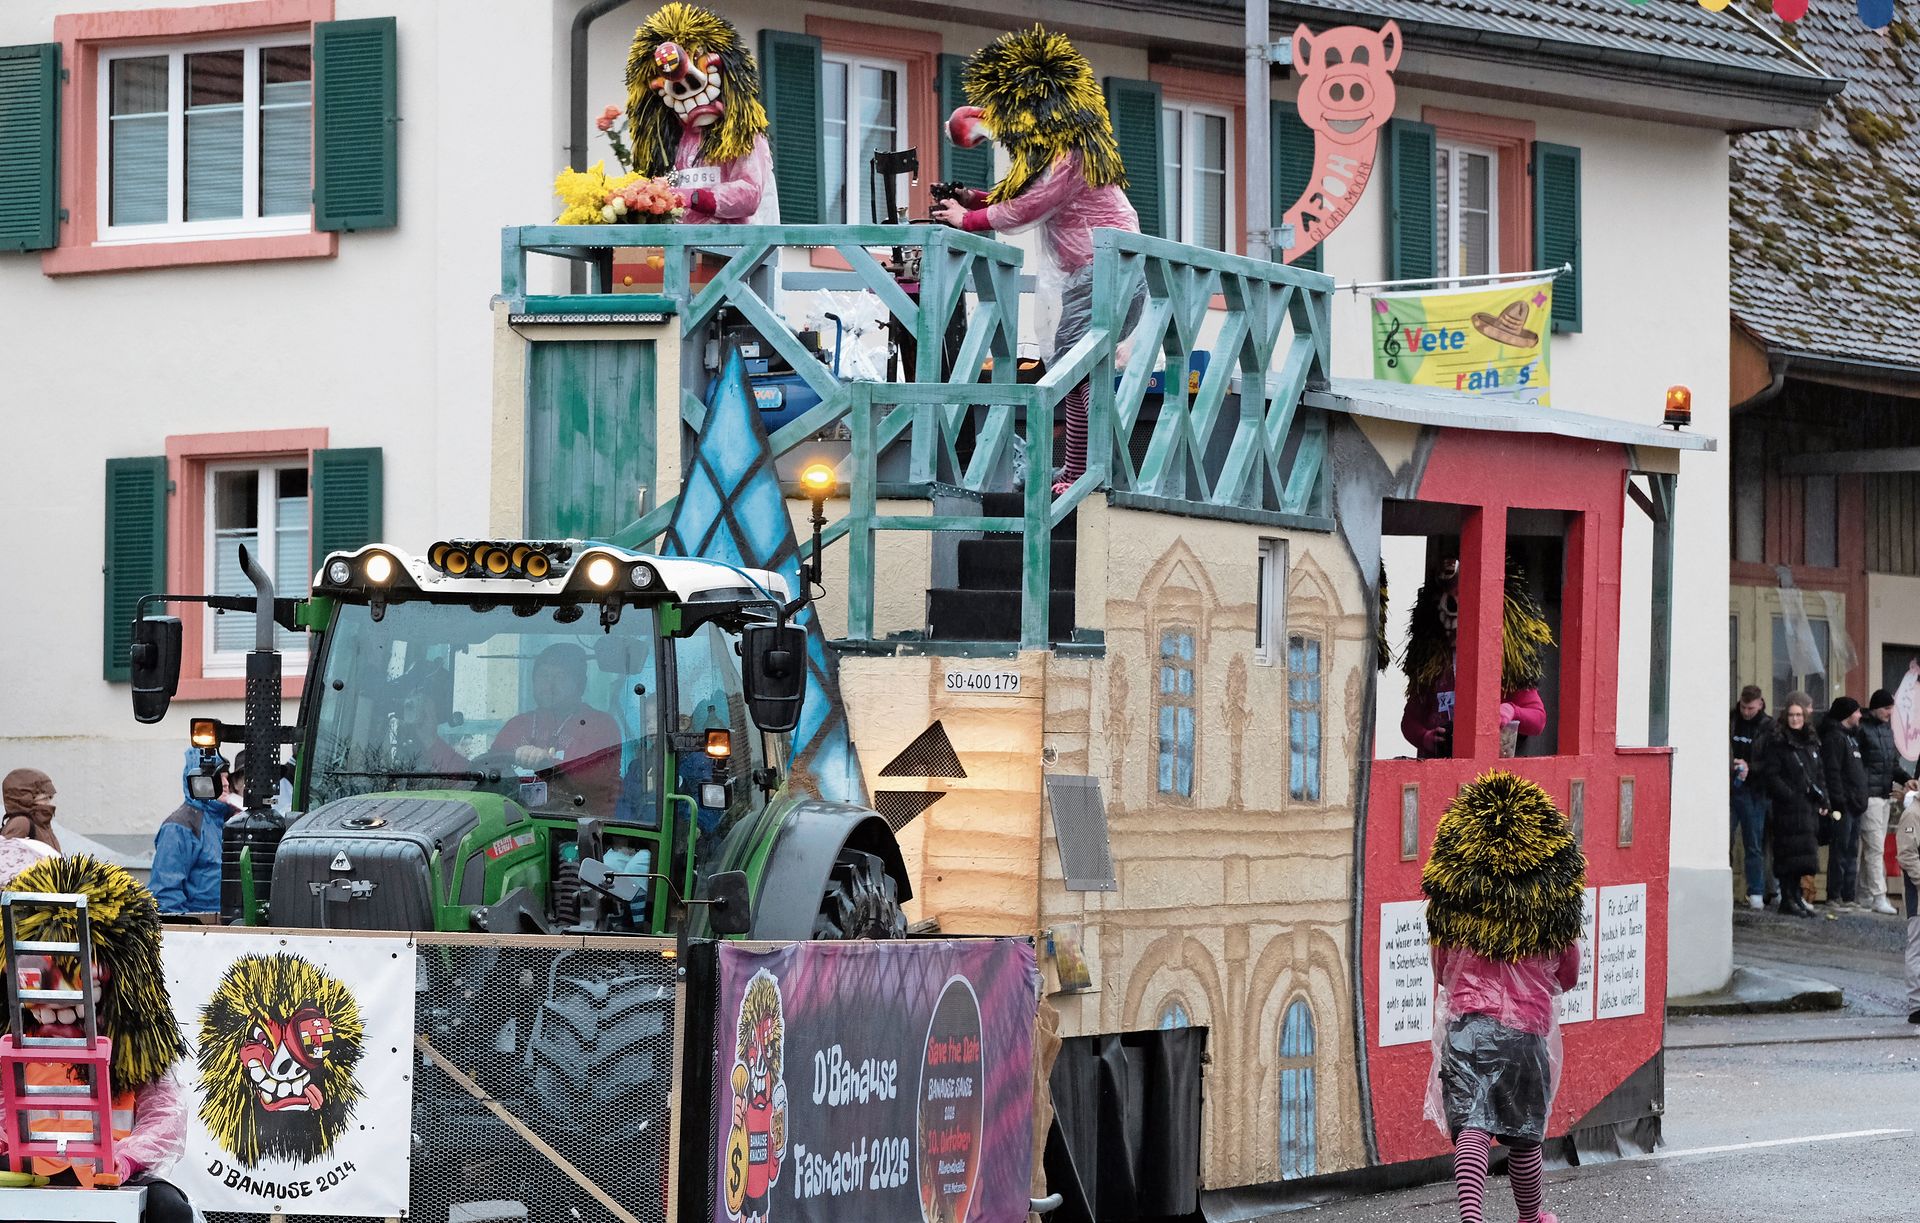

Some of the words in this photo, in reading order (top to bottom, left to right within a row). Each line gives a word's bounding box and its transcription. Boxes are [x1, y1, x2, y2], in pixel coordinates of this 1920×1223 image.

[1404, 327, 1465, 353] Vete
[995, 675, 1018, 690] 179
[928, 1034, 947, 1067] Save
[948, 1035, 961, 1064] the
[963, 1034, 980, 1064] Date
[812, 1044, 897, 1107] D'Banause
[316, 1160, 357, 1193] 2014
[794, 1137, 867, 1199] Fasnacht
[870, 1137, 910, 1190] 2026
